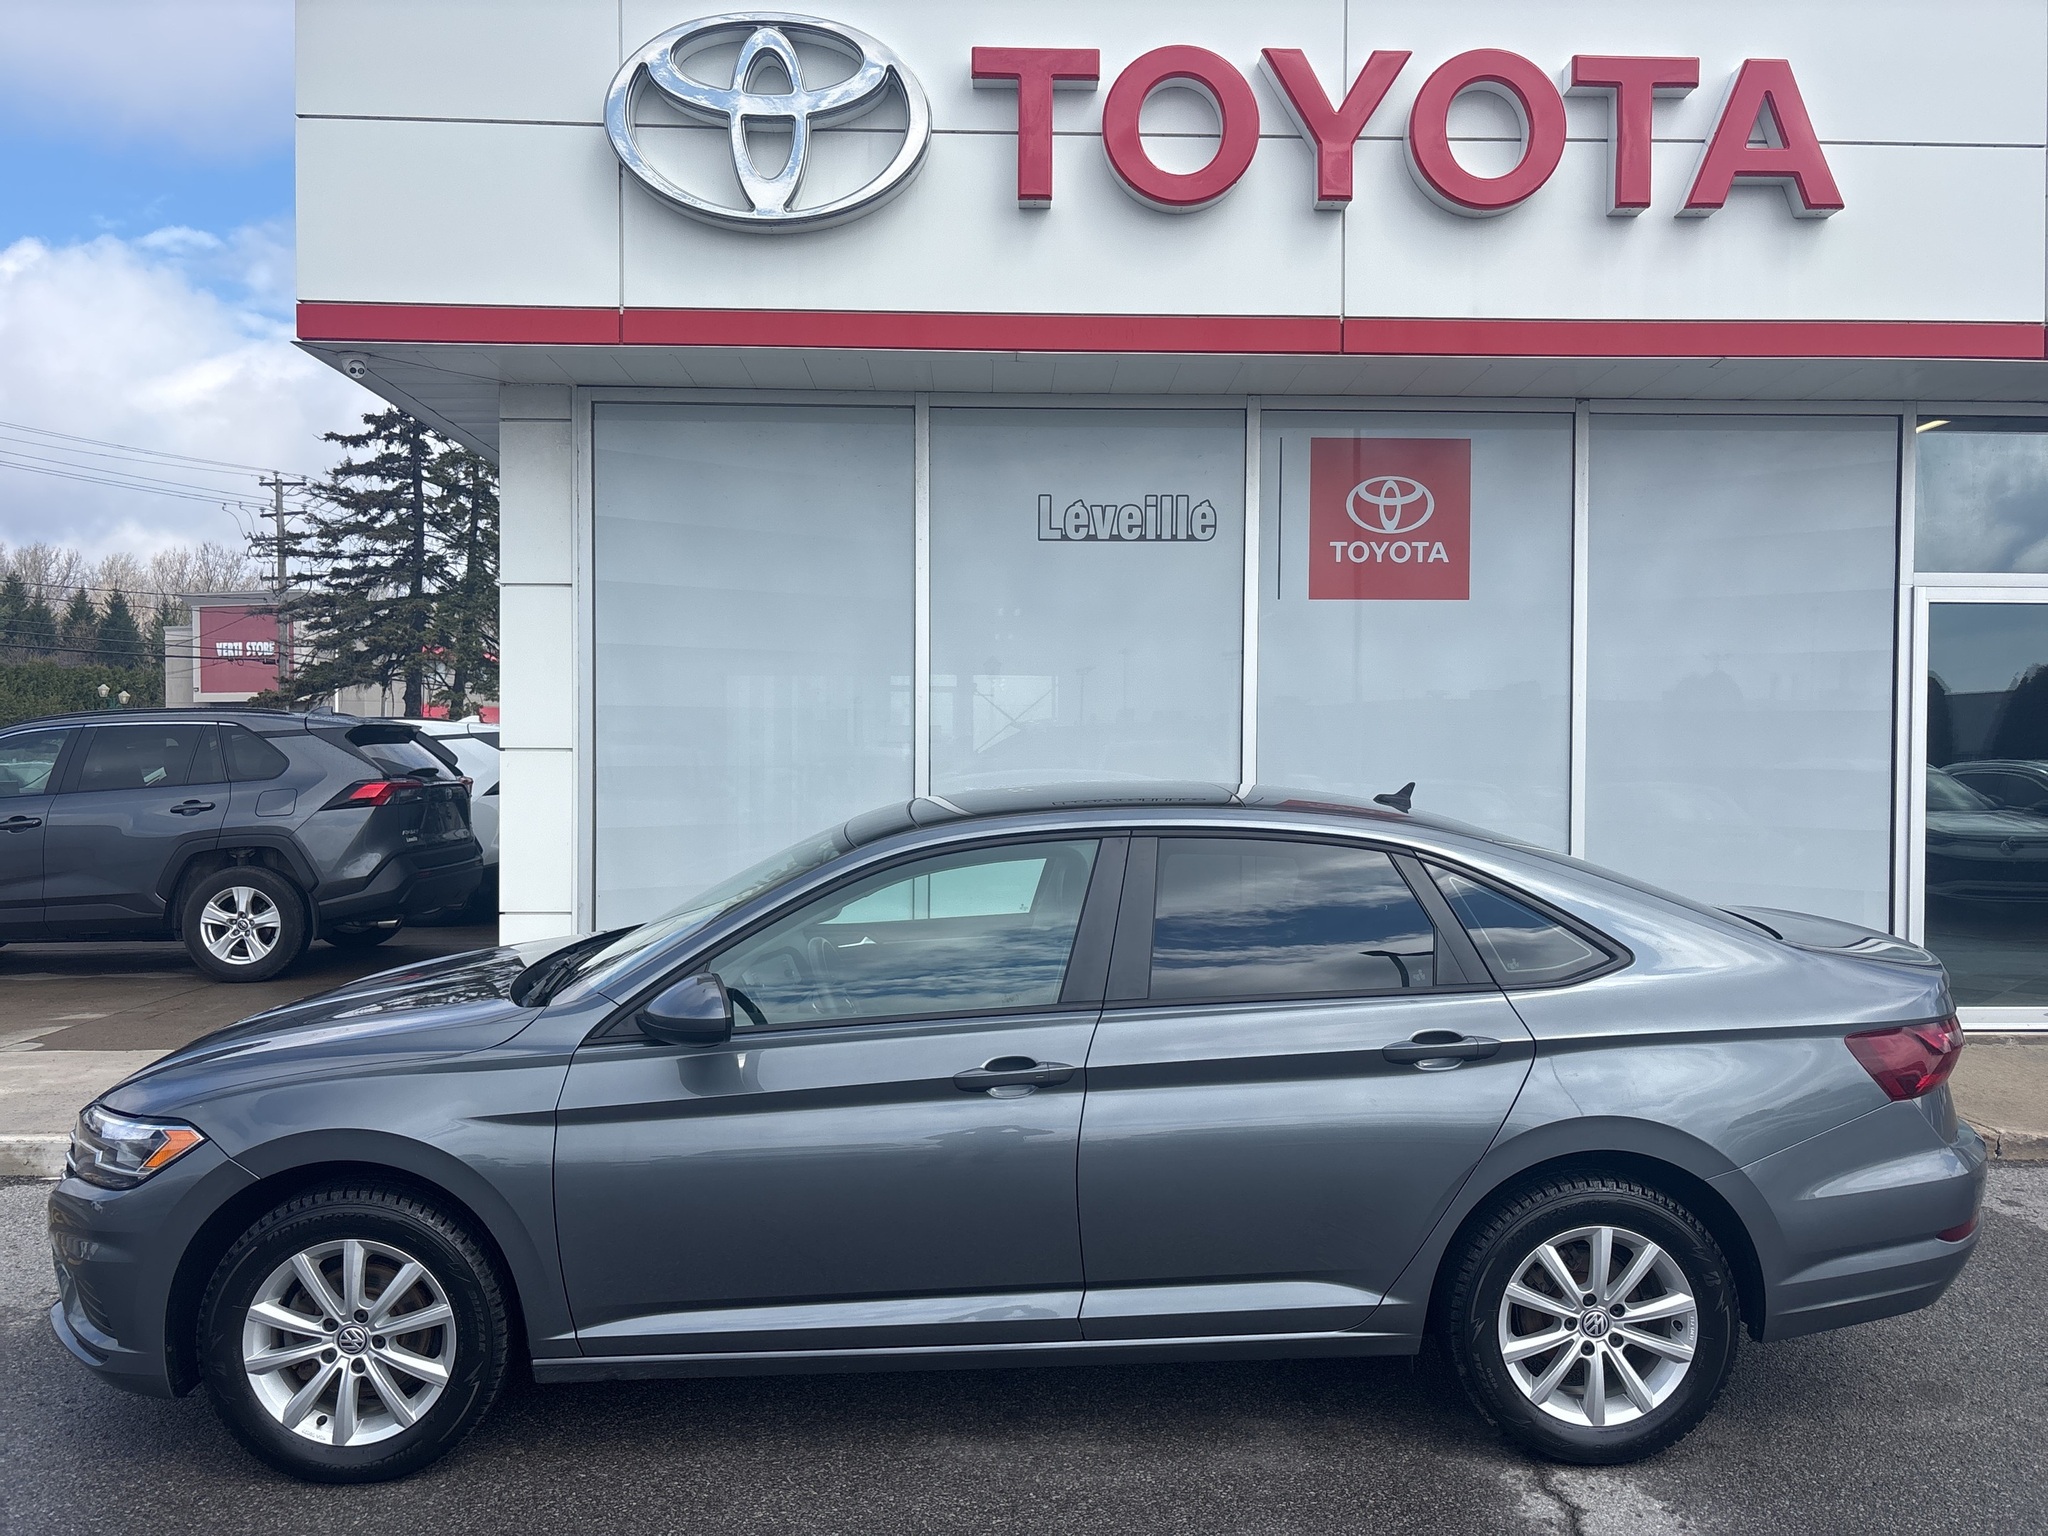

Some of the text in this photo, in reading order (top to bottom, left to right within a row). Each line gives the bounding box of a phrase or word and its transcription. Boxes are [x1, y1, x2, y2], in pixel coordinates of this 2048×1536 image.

[971, 44, 1845, 217] TOYOTA
[1038, 494, 1217, 541] Léveillé
[1329, 540, 1449, 563] TOYOTA
